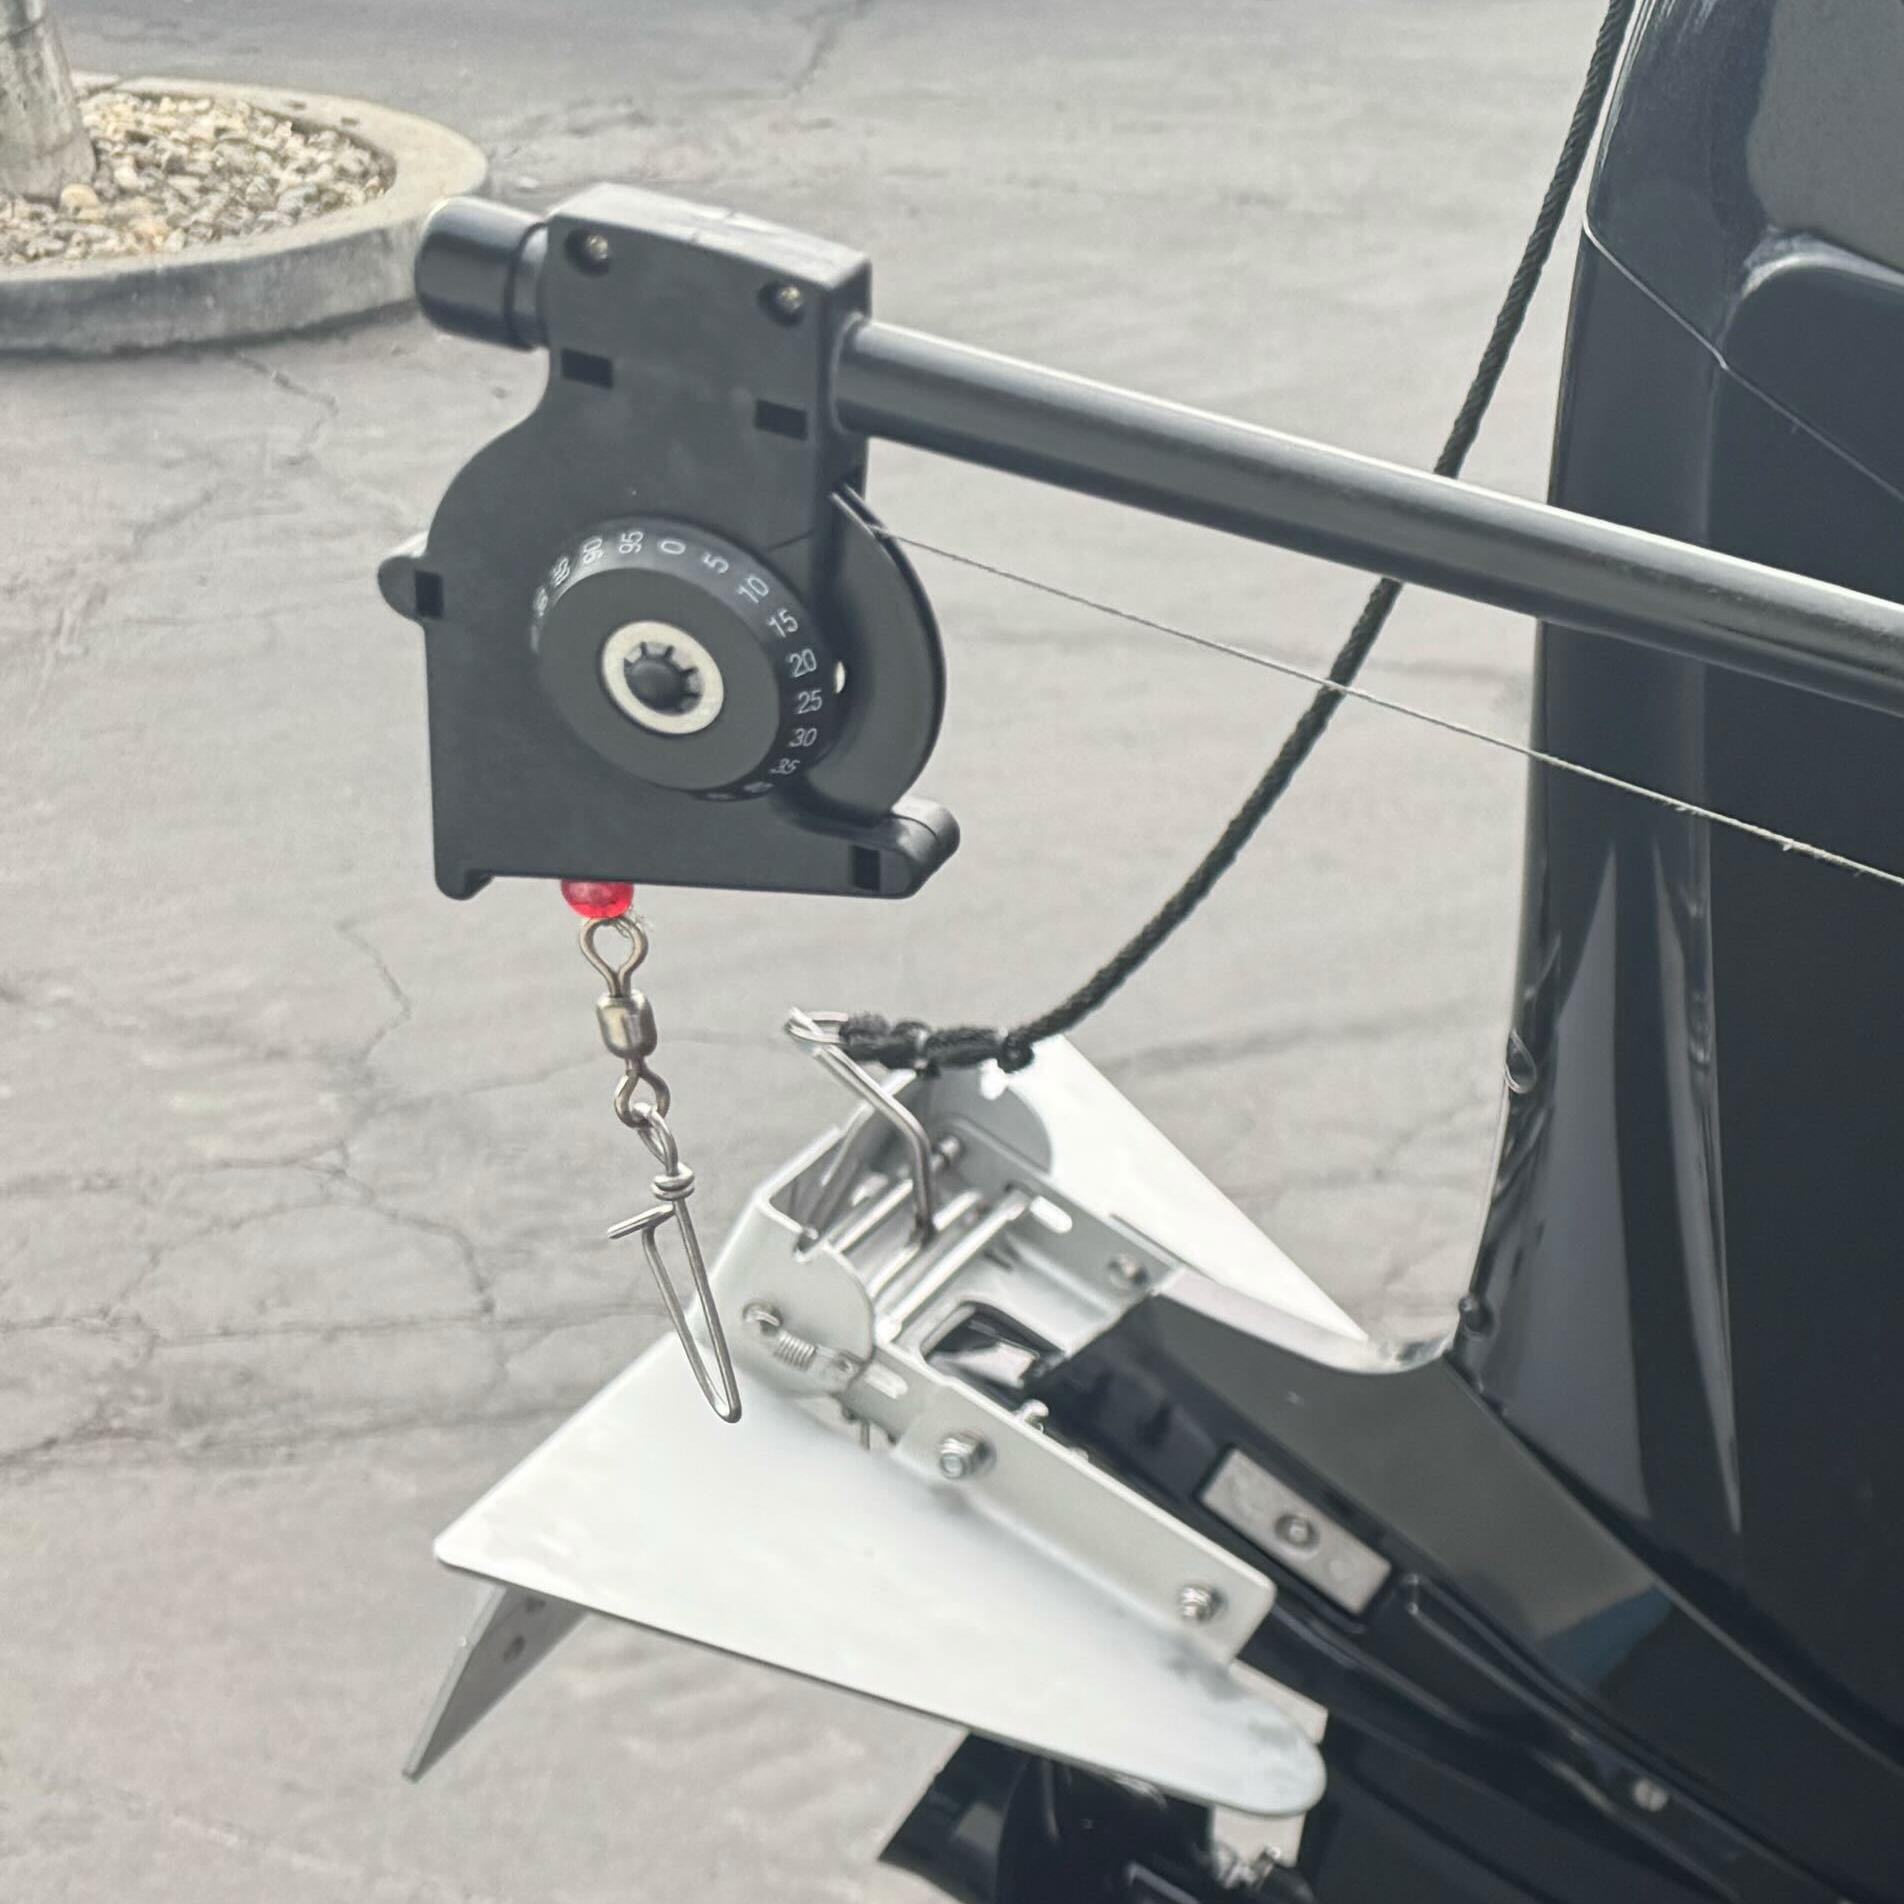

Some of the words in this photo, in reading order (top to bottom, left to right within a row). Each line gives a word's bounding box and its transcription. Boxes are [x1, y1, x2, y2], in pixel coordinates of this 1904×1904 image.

[618, 529, 644, 554] 95
[657, 538, 687, 555] 0
[701, 552, 730, 575] 5
[736, 575, 770, 604] 10
[766, 607, 799, 638] 15
[786, 648, 818, 678] 20
[796, 689, 823, 714] 25
[789, 727, 818, 748] 30
